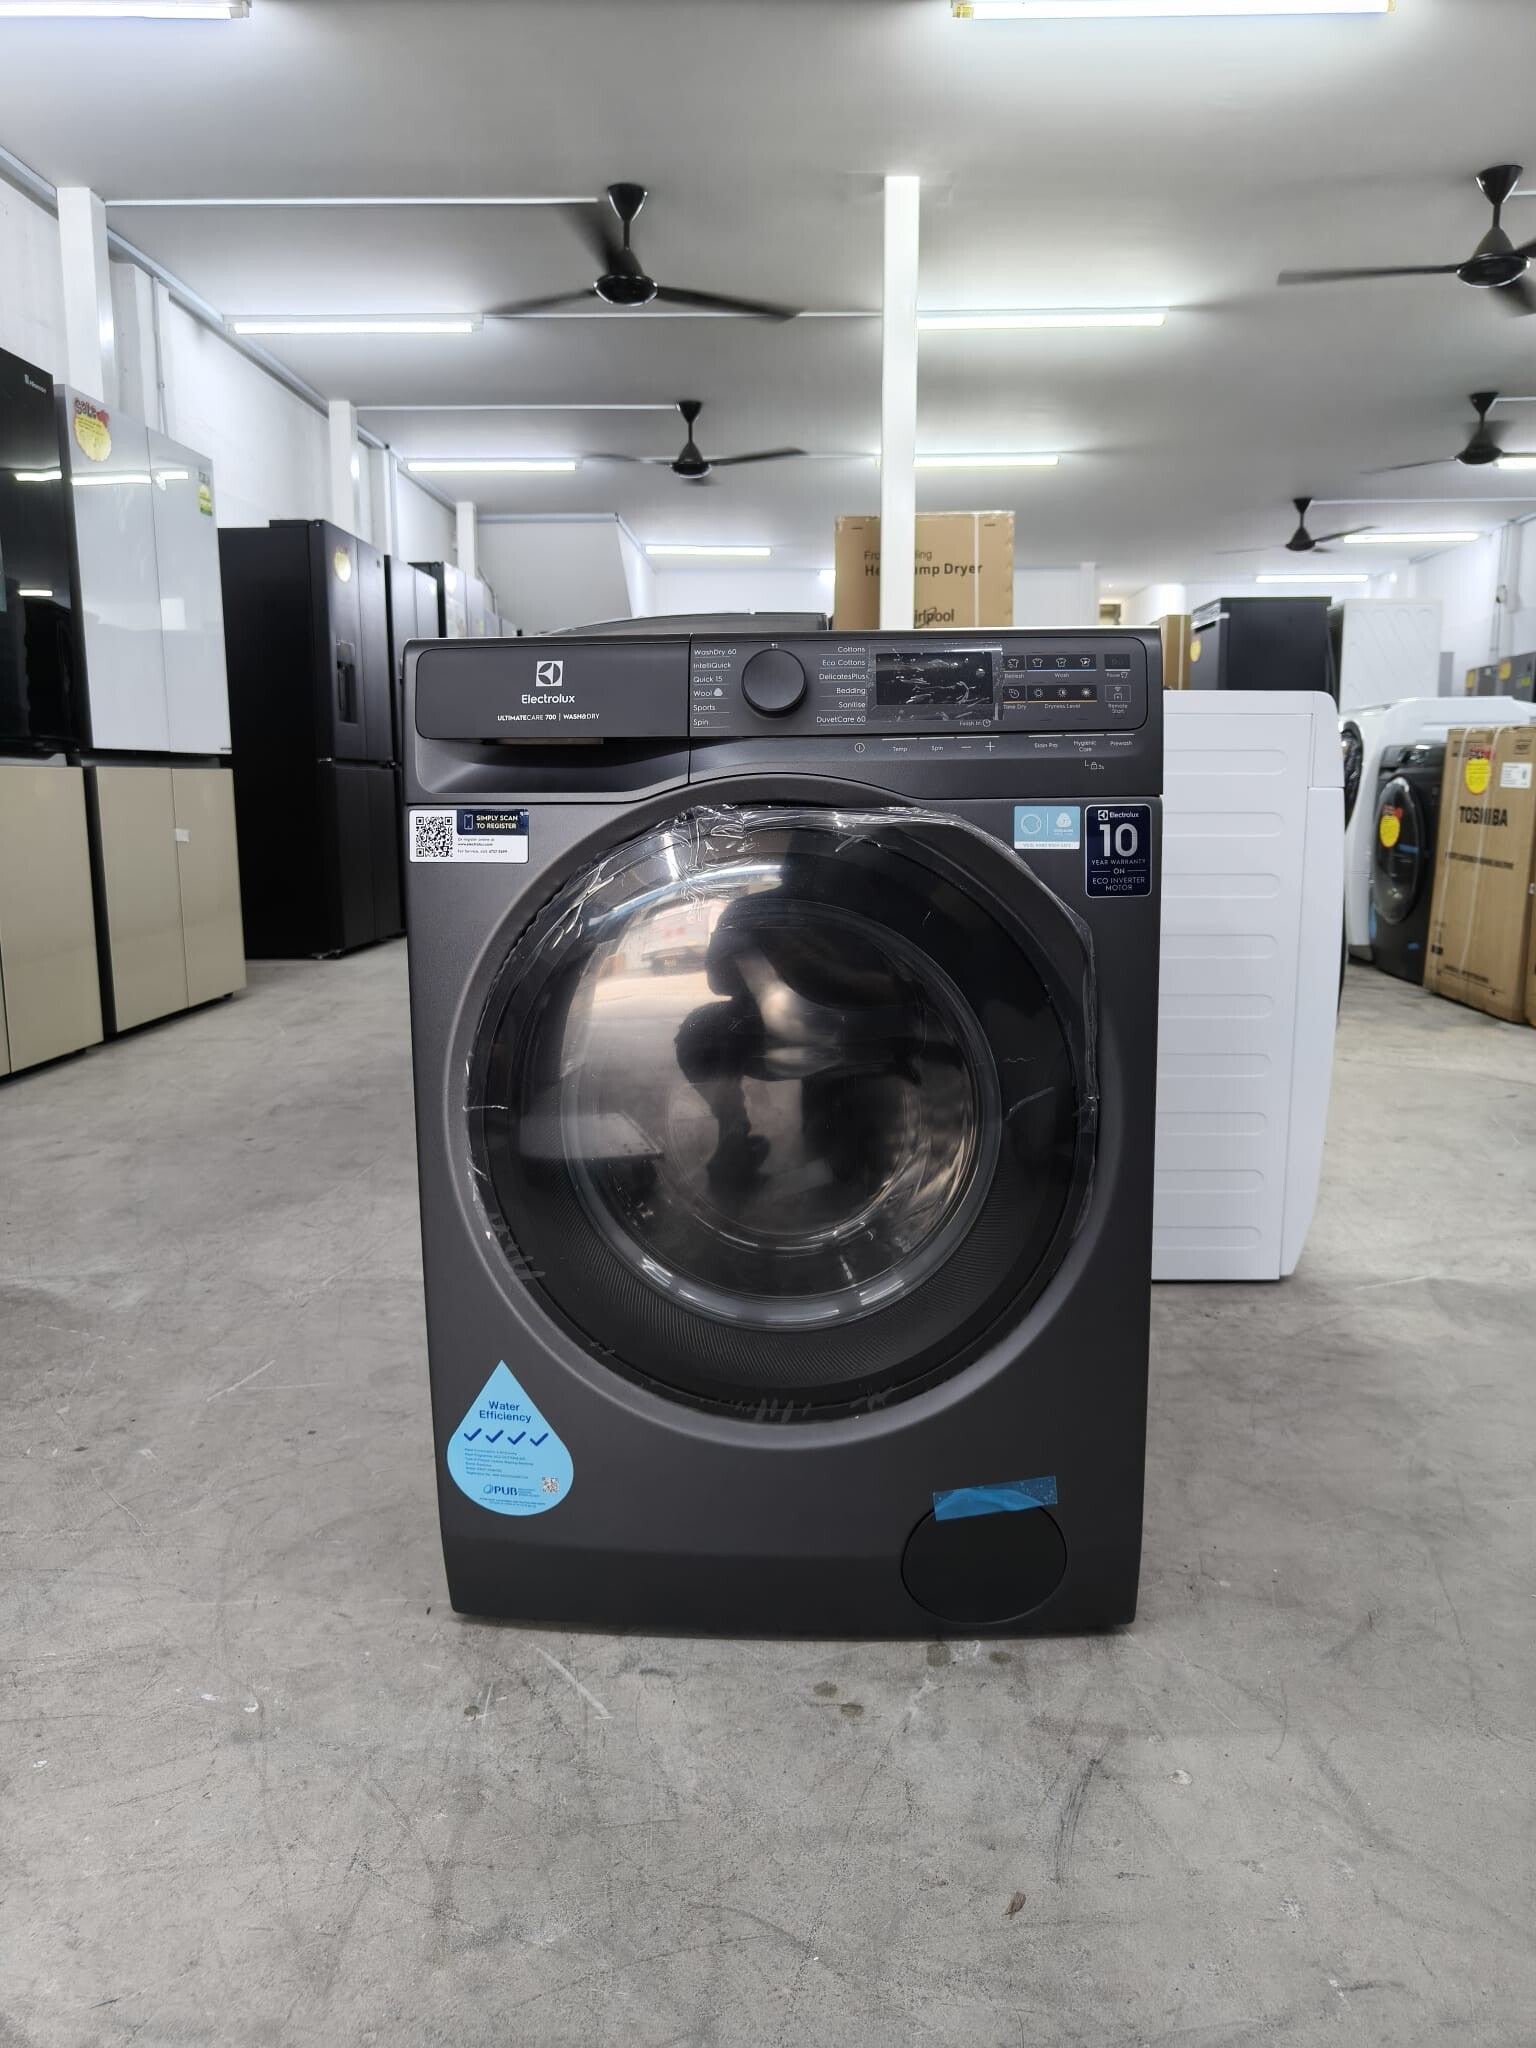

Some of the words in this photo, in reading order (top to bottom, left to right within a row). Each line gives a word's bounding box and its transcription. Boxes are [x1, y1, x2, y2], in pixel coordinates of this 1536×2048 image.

[865, 564, 881, 576] He
[944, 562, 983, 577] Dryer
[693, 661, 731, 669] IntelliQuick
[836, 687, 866, 695] Bedding
[521, 693, 575, 704] Electrolux
[693, 704, 716, 712] Sports
[838, 701, 866, 709] Sanitise
[693, 718, 709, 727] Spin
[856, 715, 866, 723] 60
[1459, 806, 1508, 827] TOSHIBA
[1099, 822, 1139, 857] 10
[1113, 867, 1126, 875] ON
[1105, 884, 1133, 892] MOTOR
[488, 1399, 520, 1411] Water
[479, 1410, 532, 1424] Efficiency
[494, 1485, 518, 1496] PUB
